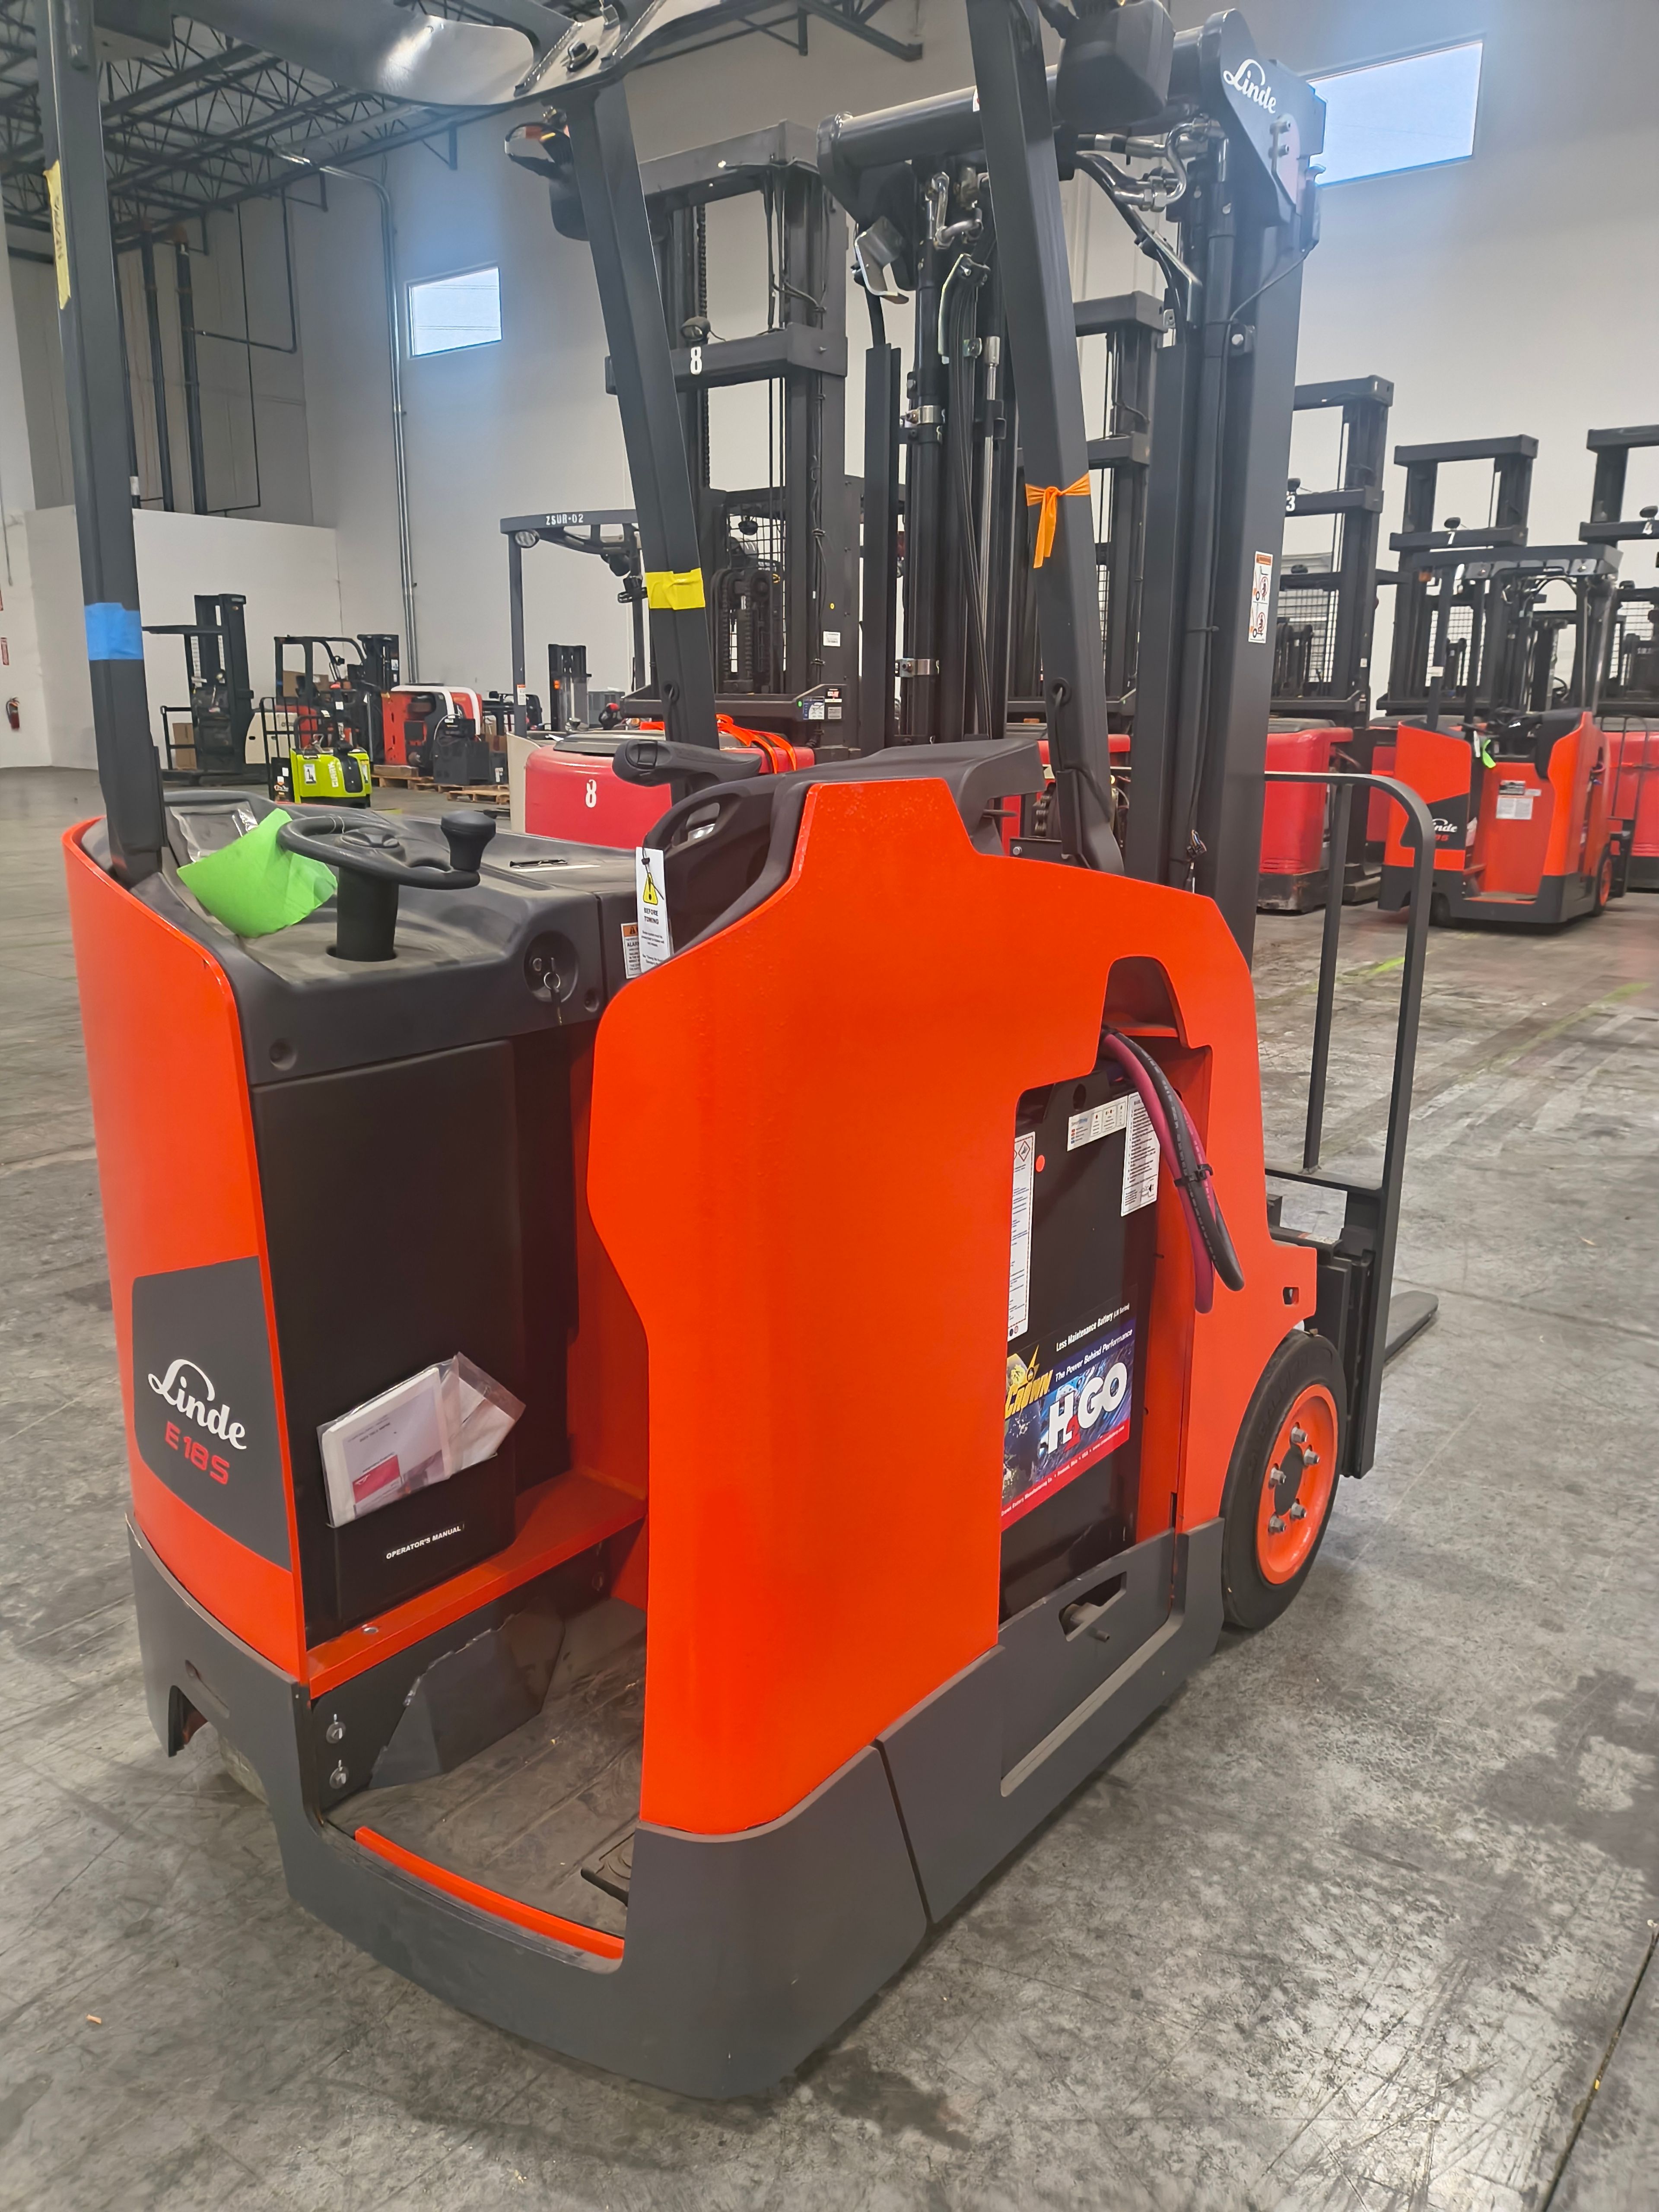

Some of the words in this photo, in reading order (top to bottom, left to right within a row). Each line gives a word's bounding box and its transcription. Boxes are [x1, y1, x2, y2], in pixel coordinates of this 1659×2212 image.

[1223, 59, 1276, 114] Linde
[690, 346, 702, 375] 8
[1286, 495, 1295, 512] 3
[1447, 531, 1456, 545] 7
[585, 779, 597, 808] 8
[644, 907, 658, 916] BEFORE
[1056, 1339, 1067, 1352] Less
[1067, 1322, 1097, 1345] Maintenance
[1097, 1312, 1113, 1328] Battery
[1055, 1370, 1066, 1382] The
[1066, 1360, 1084, 1376] Power
[1084, 1346, 1102, 1364] Behind
[1102, 1329, 1133, 1353] Performance
[148, 1359, 247, 1450] Linde
[386, 1537, 431, 1560] OPERATOR'S
[432, 1526, 461, 1541] MANUAL
